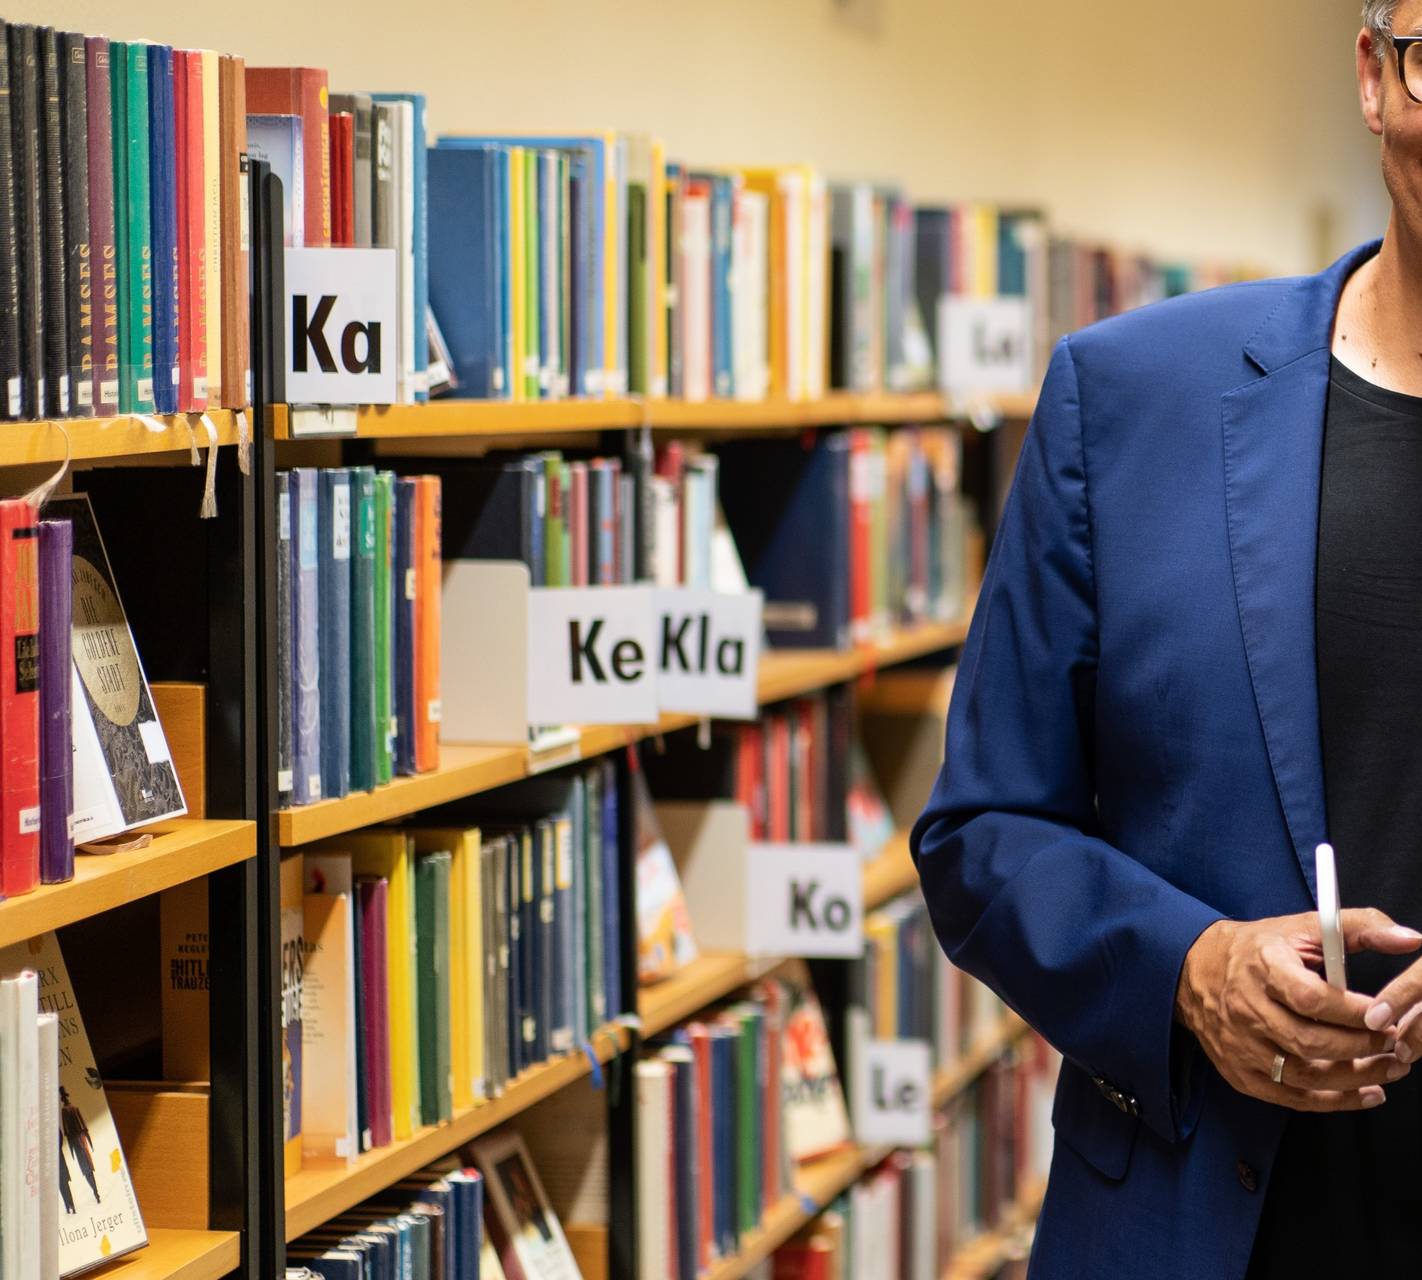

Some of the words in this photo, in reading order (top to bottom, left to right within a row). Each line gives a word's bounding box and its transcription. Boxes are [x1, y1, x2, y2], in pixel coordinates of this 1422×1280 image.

[292, 295, 382, 374] Ka
[80, 596, 100, 625] DIE
[81, 628, 121, 660] GOLDENE
[569, 619, 644, 683] Ke
[662, 614, 744, 675] Kla
[96, 663, 126, 695] STADT
[790, 879, 852, 931] Ko
[873, 1066, 915, 1109] Le
[60, 1225, 88, 1247] Ilona
[90, 1212, 125, 1240] Jerger
